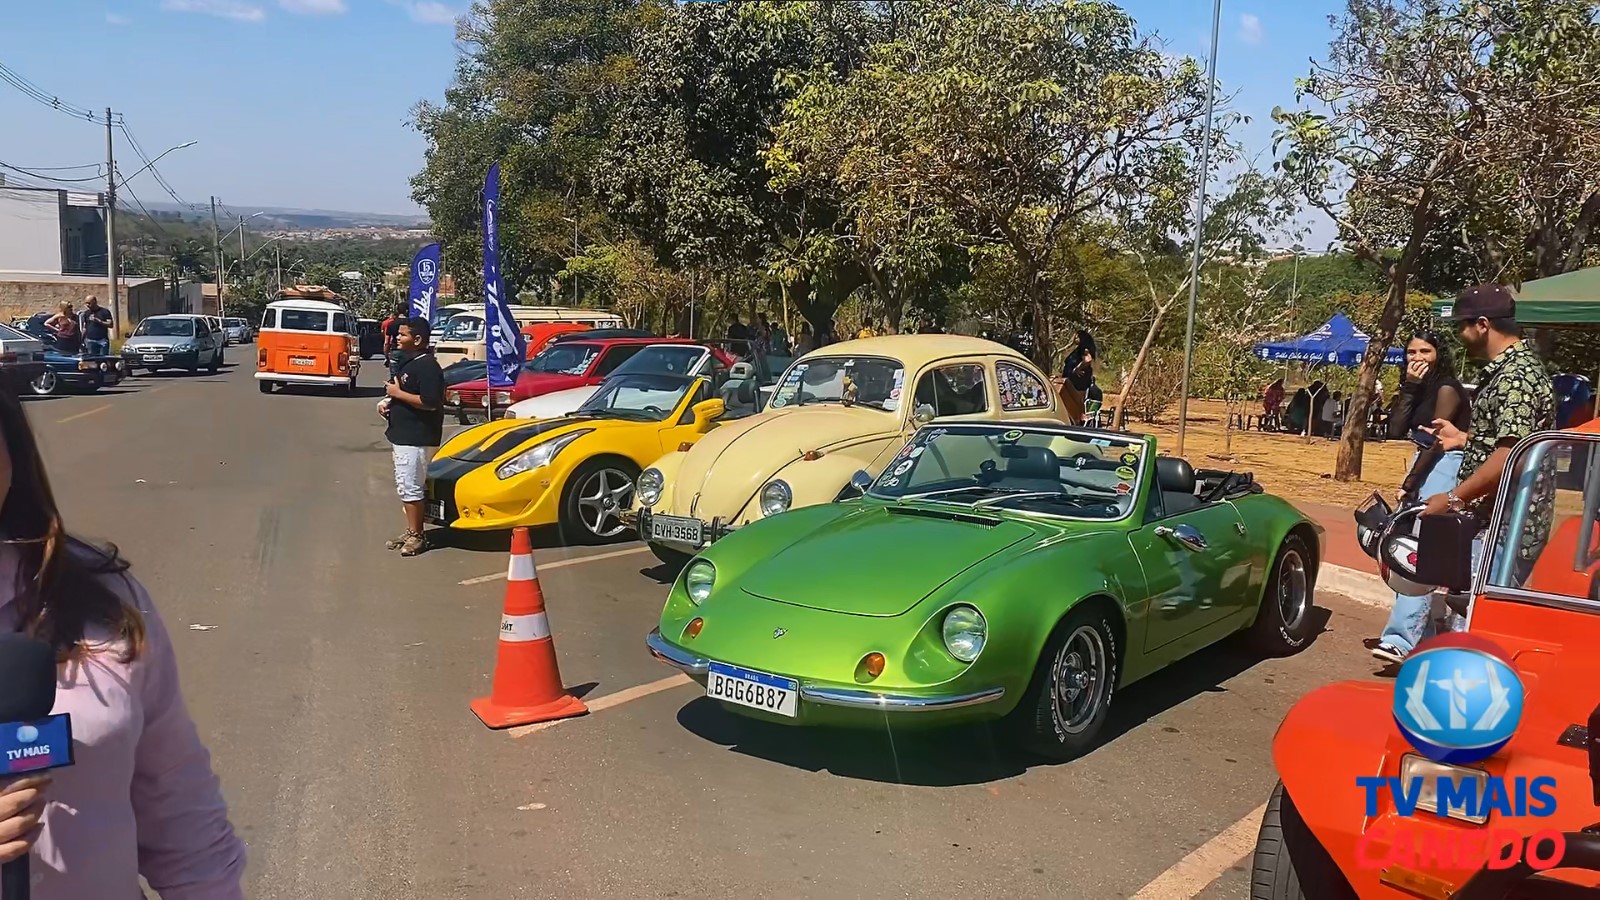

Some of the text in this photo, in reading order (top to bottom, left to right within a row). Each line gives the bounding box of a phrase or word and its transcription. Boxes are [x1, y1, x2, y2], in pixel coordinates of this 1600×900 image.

[654, 523, 699, 541] CVH-3568
[744, 673, 760, 682] BRASIL
[714, 675, 787, 711] BGG6B87
[6, 744, 51, 760] TV MAIS
